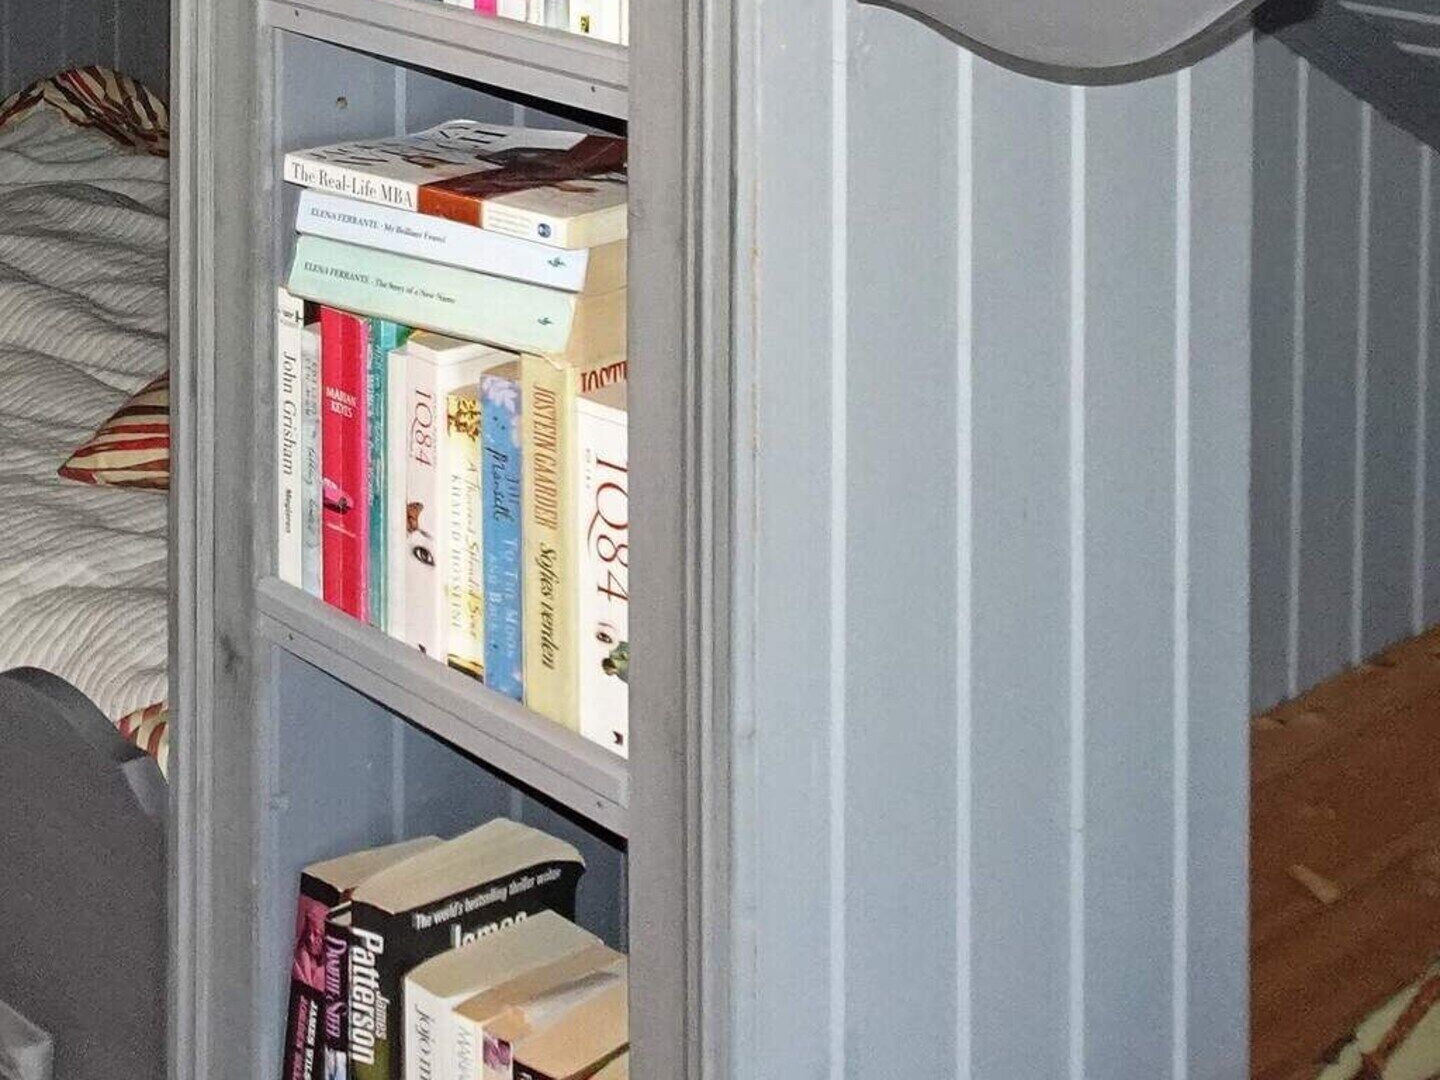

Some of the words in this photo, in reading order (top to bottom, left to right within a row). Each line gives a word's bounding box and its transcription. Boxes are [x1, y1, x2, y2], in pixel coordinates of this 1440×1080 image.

[292, 161, 316, 184] The
[318, 170, 378, 199] Real-Life
[380, 184, 413, 208] MBA
[310, 207, 337, 221] ELENA
[337, 211, 380, 230] FERRANTE
[304, 261, 328, 275] ELENA
[329, 267, 370, 285] FERRANTE
[375, 278, 387, 289] The
[283, 351, 297, 394] John
[325, 385, 357, 407] MARIAN
[330, 400, 353, 419] KEYES
[410, 388, 433, 467] 1Q84
[533, 384, 557, 452] JOSTEIN
[283, 400, 297, 476] Grisham
[533, 453, 558, 532] GAARDER
[588, 456, 628, 603] 1Q84
[535, 541, 558, 598] Sofies
[539, 602, 560, 670] verden
[415, 913, 432, 930] The
[433, 900, 463, 924] world's
[463, 886, 508, 913] bestselling
[351, 927, 384, 1066] Patterson
[374, 991, 390, 1040] James
[308, 999, 319, 1046] JAMES
